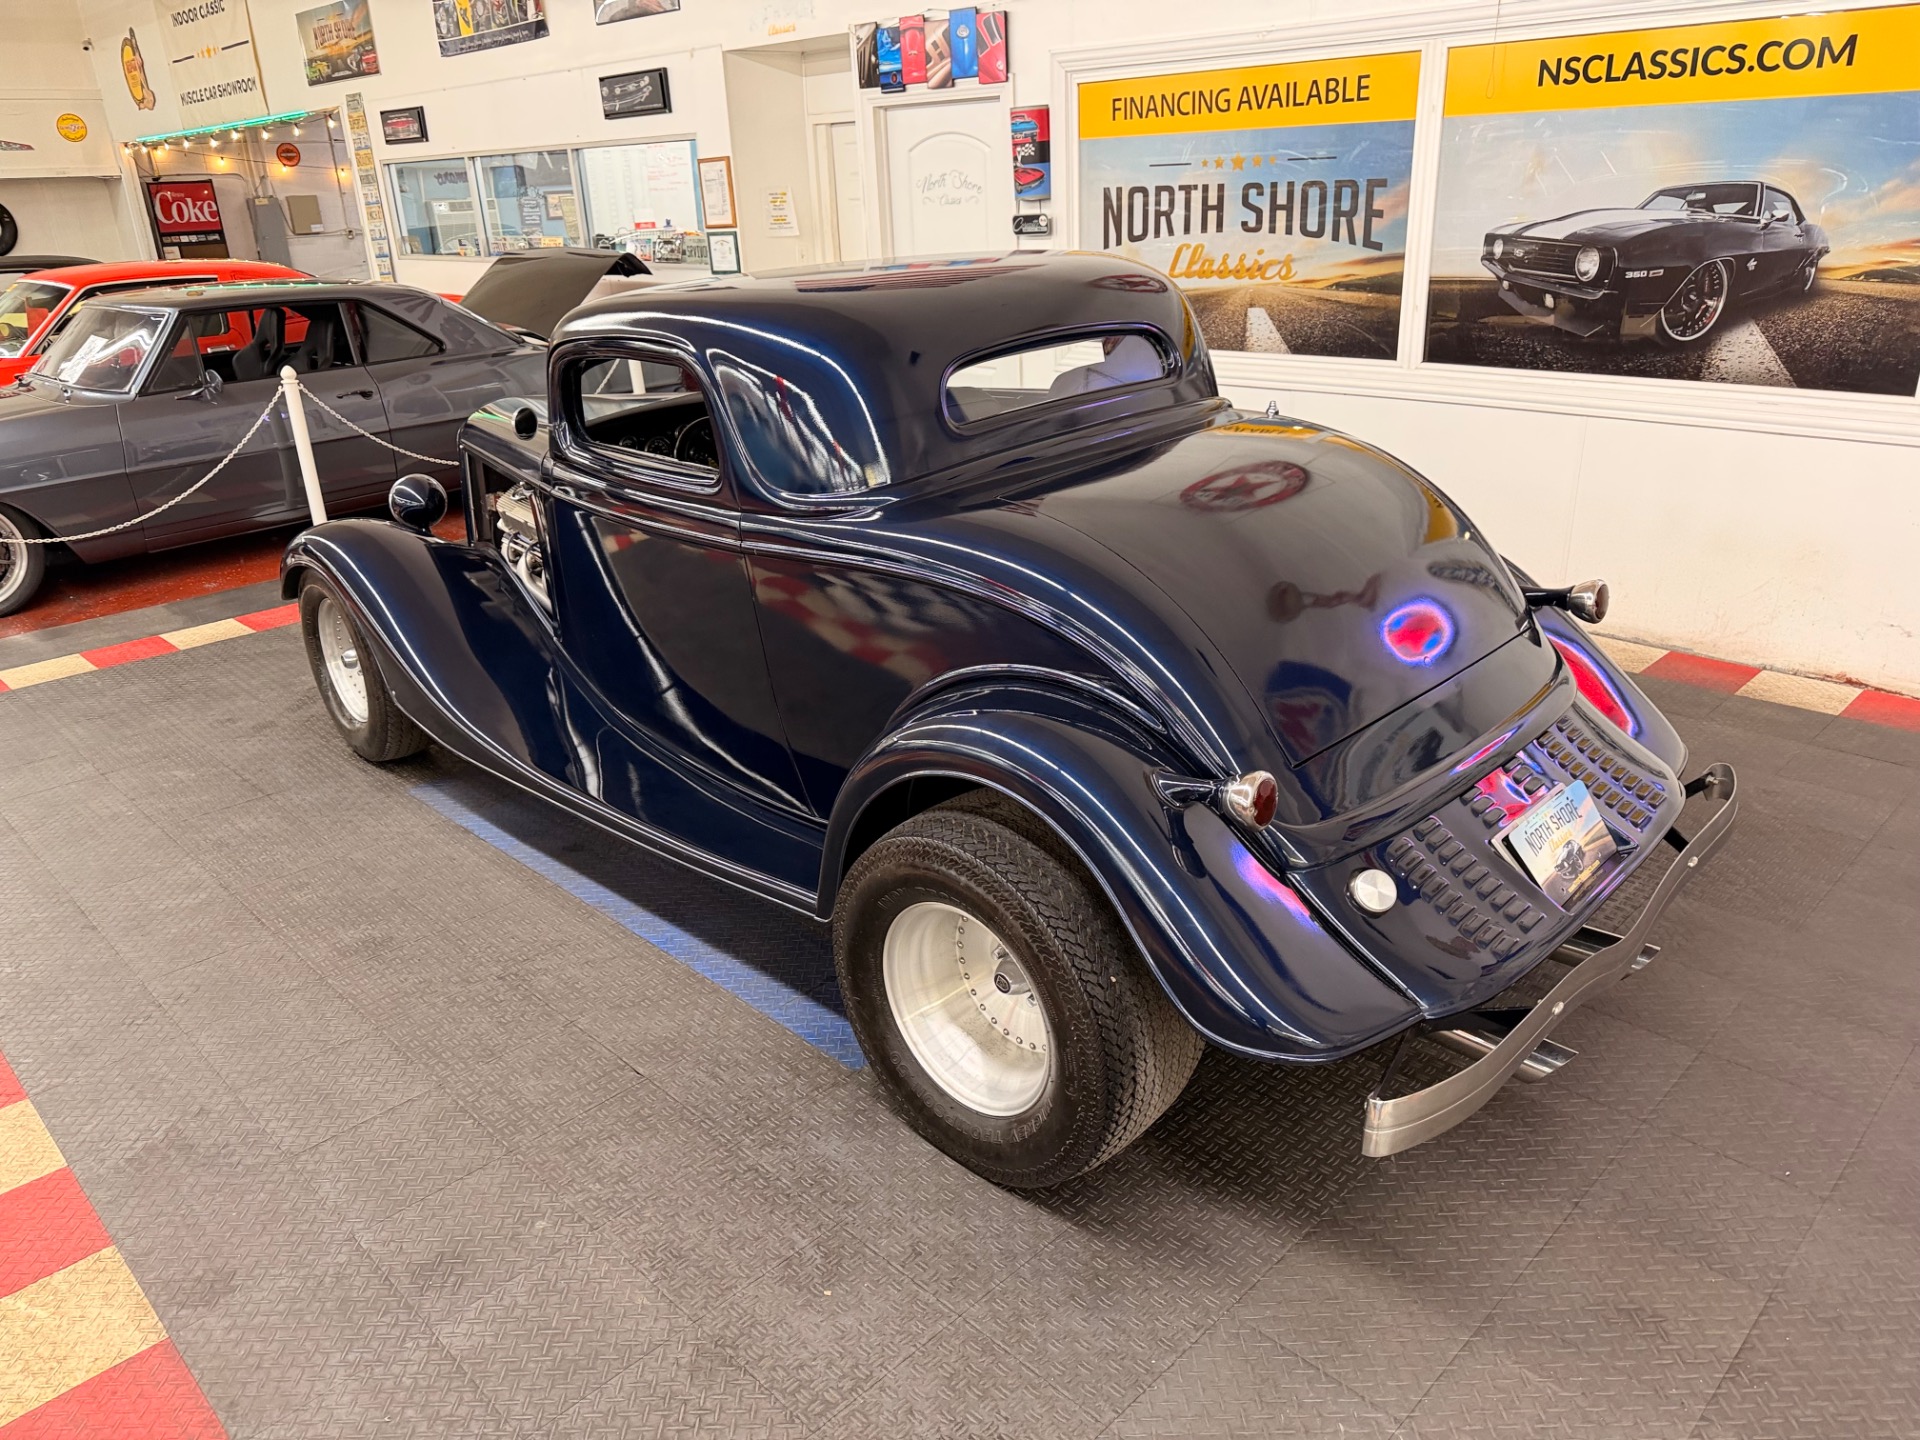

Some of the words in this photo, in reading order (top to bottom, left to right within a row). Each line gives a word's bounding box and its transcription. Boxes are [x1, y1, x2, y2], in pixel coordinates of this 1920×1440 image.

[170, 7, 199, 27] INDOOR
[199, 0, 225, 19] CLASSIC
[1538, 33, 1858, 87] NSCLASSICS.COM
[180, 89, 205, 106] MUSCLE
[204, 85, 218, 100] CAR
[217, 76, 257, 98] SHOWROOM
[1111, 88, 1231, 121] FINANCING
[1237, 74, 1371, 112] AVAILABLE
[155, 191, 219, 224] Coke
[1102, 183, 1225, 250] NORTH
[1240, 178, 1388, 252] SHORE
[1168, 243, 1298, 281] Classics
[1625, 270, 1648, 279] 350
[1524, 820, 1554, 857] NORTH
[1549, 799, 1583, 830] SHORE
